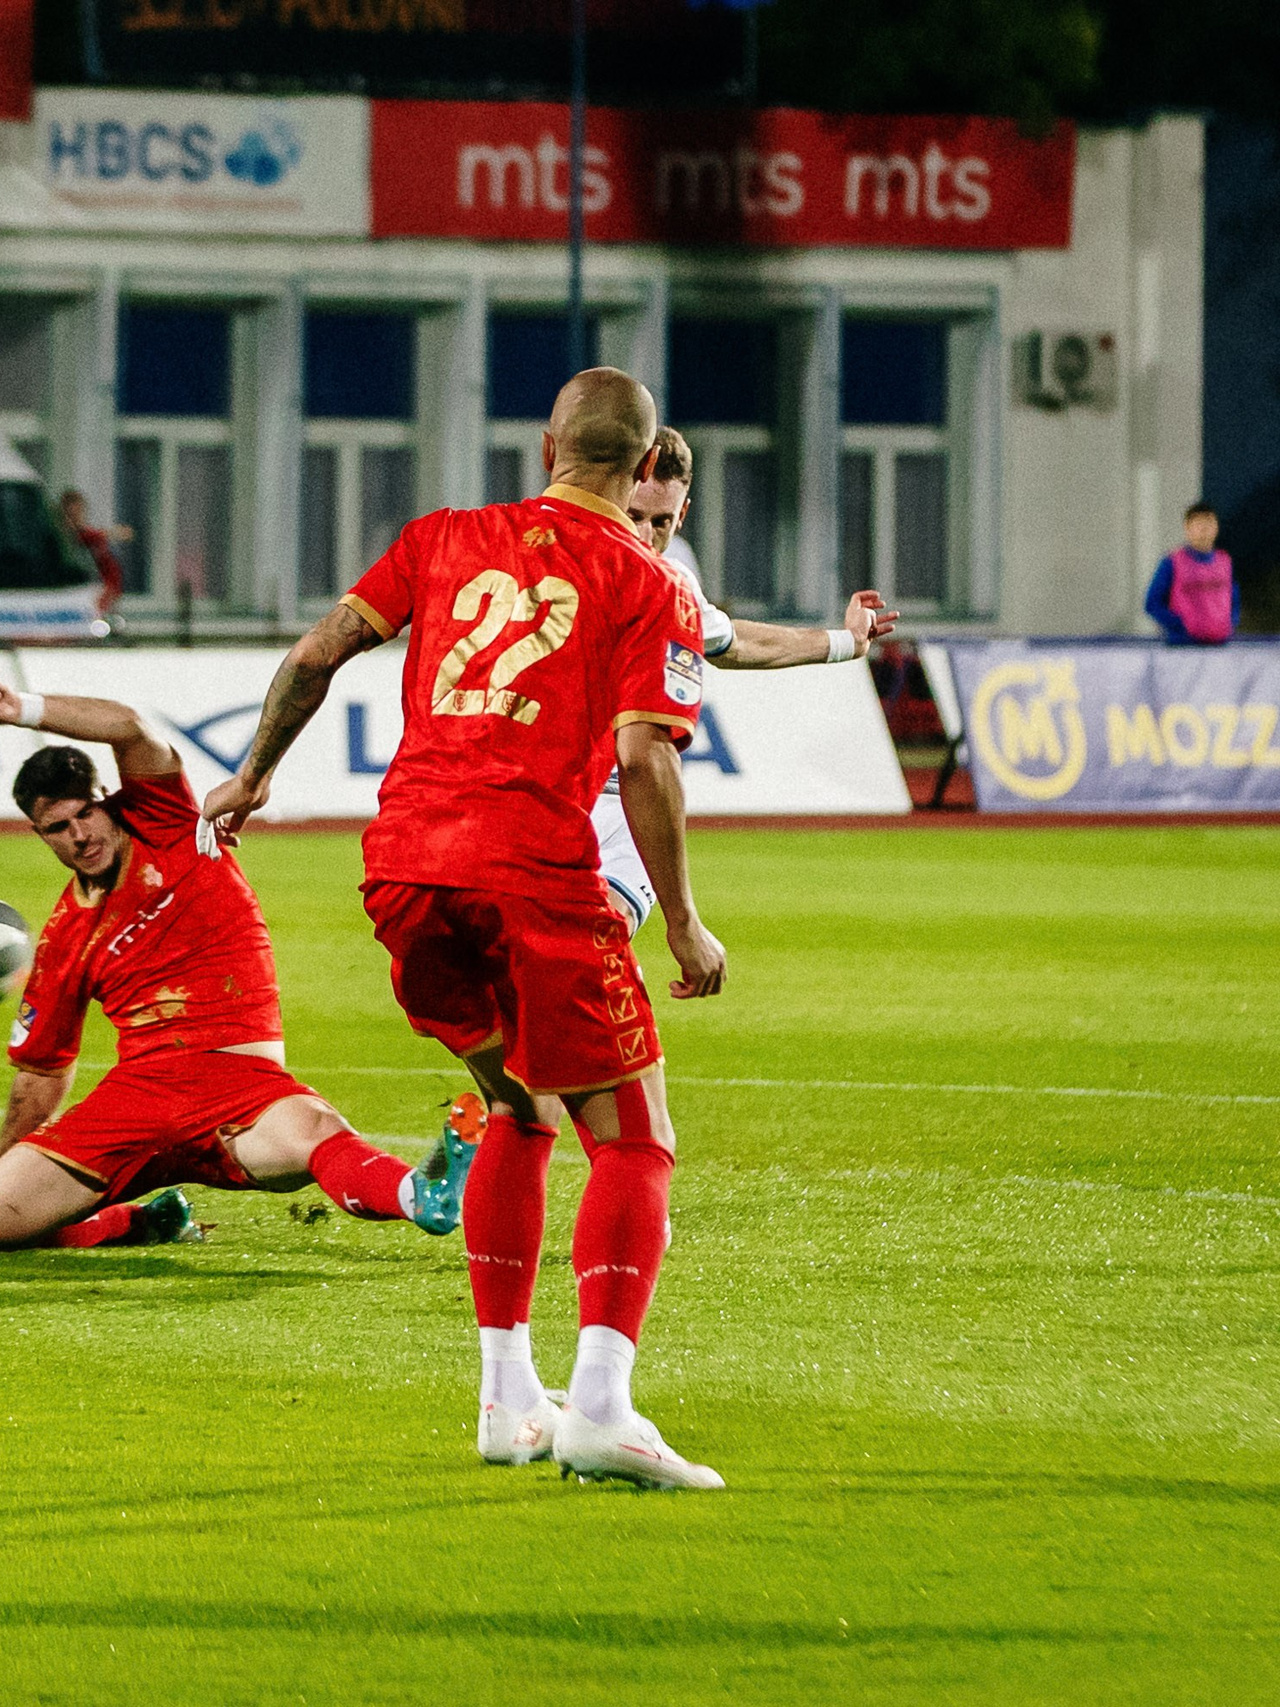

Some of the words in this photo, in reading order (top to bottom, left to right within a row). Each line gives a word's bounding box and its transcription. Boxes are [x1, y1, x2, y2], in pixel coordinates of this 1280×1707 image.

[47, 118, 218, 183] HBCS
[456, 133, 612, 213] mts
[654, 137, 806, 219] mts
[843, 141, 992, 221] mts
[431, 568, 580, 727] 22
